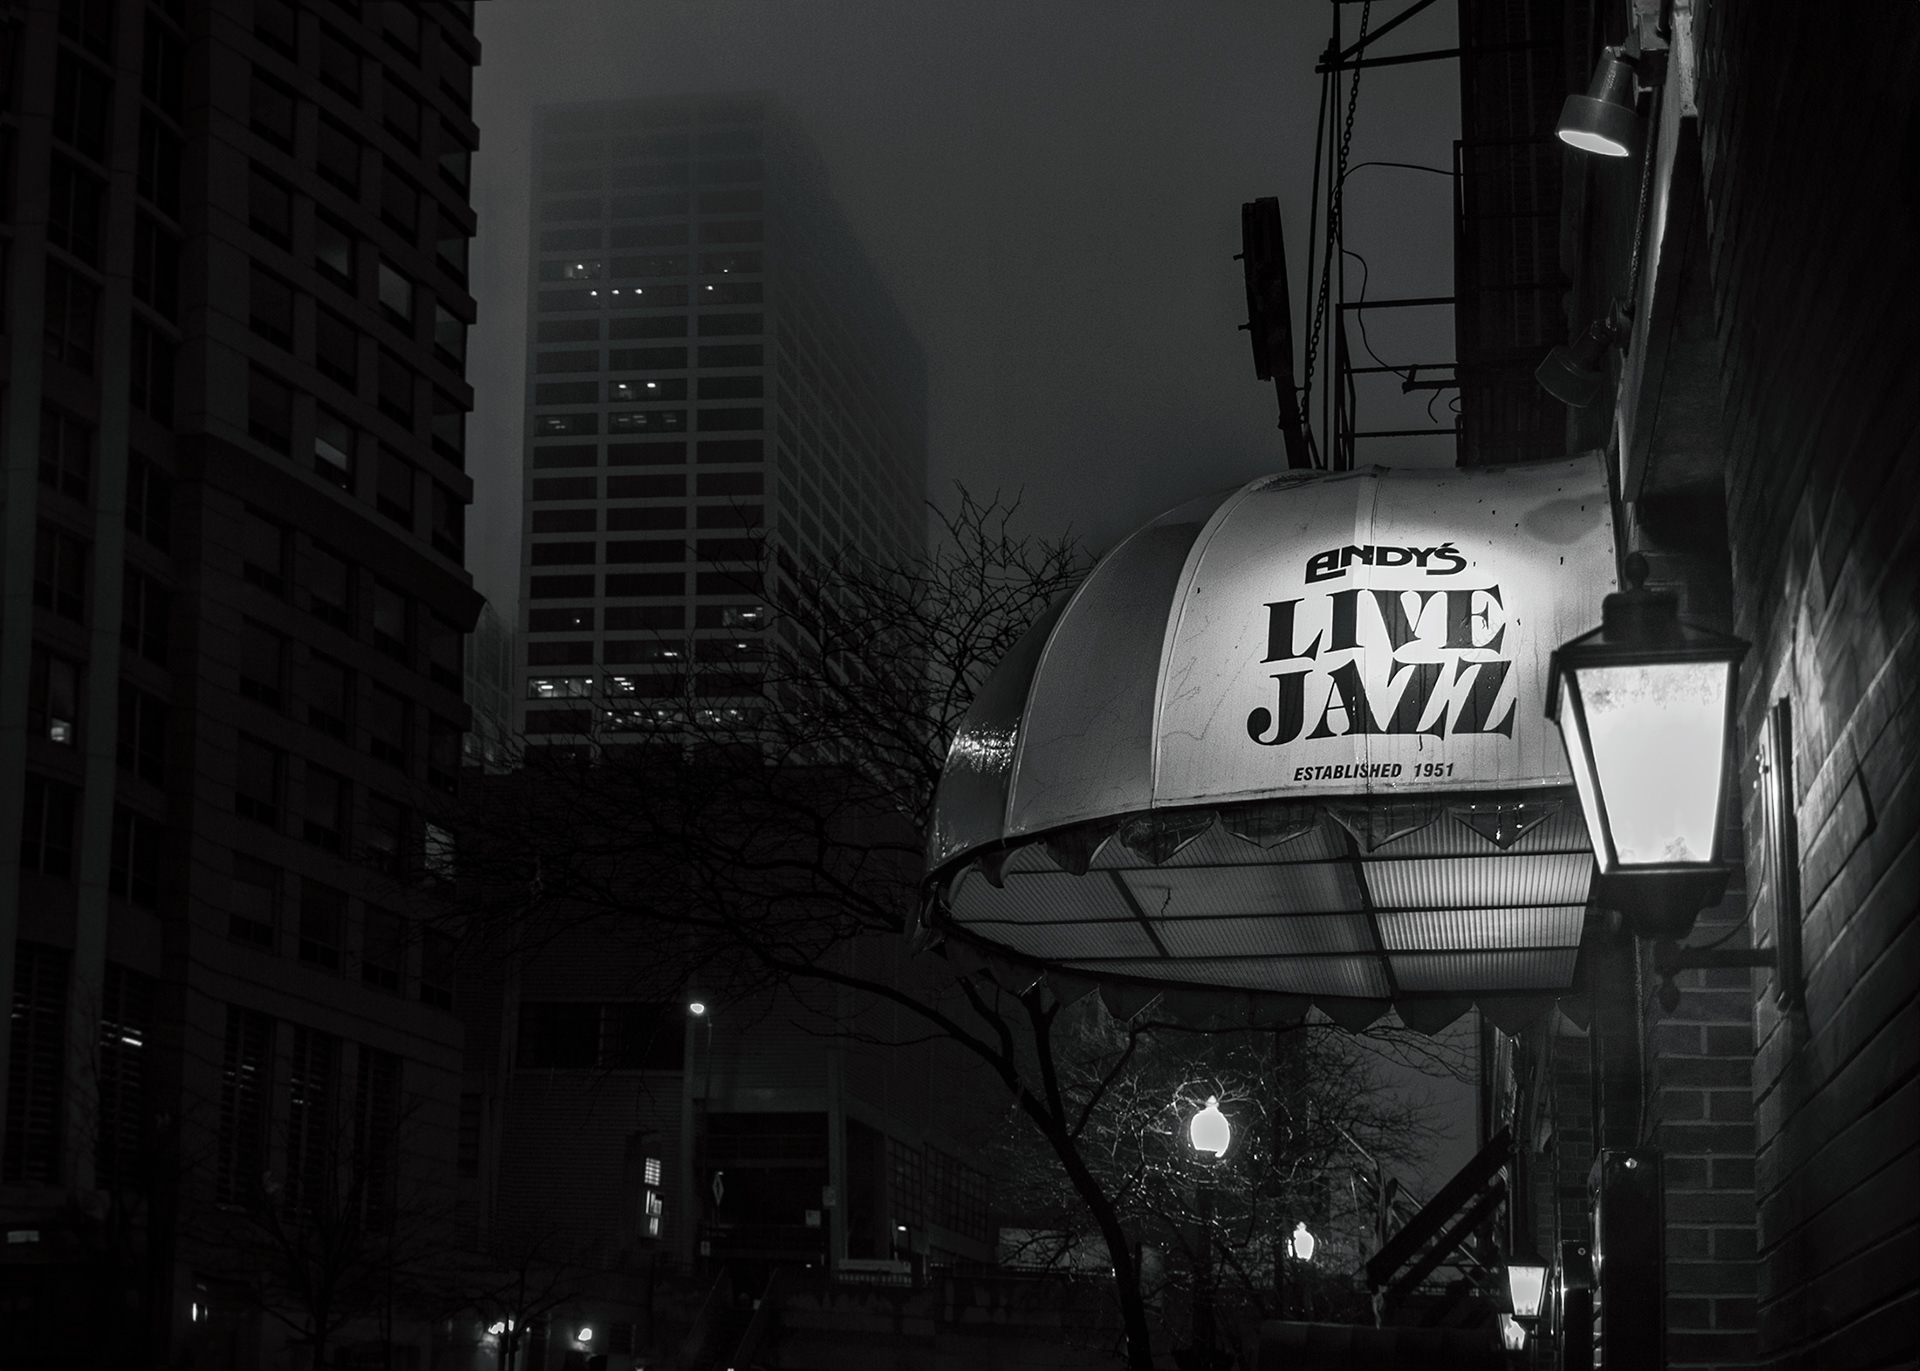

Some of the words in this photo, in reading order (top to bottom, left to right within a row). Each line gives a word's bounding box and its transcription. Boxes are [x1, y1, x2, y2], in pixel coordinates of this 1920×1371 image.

[1260, 584, 1506, 663] LIVE
[1247, 656, 1516, 745] JAZZ
[1293, 763, 1402, 781] ESTABLISHED
[1413, 763, 1454, 777] 1951
